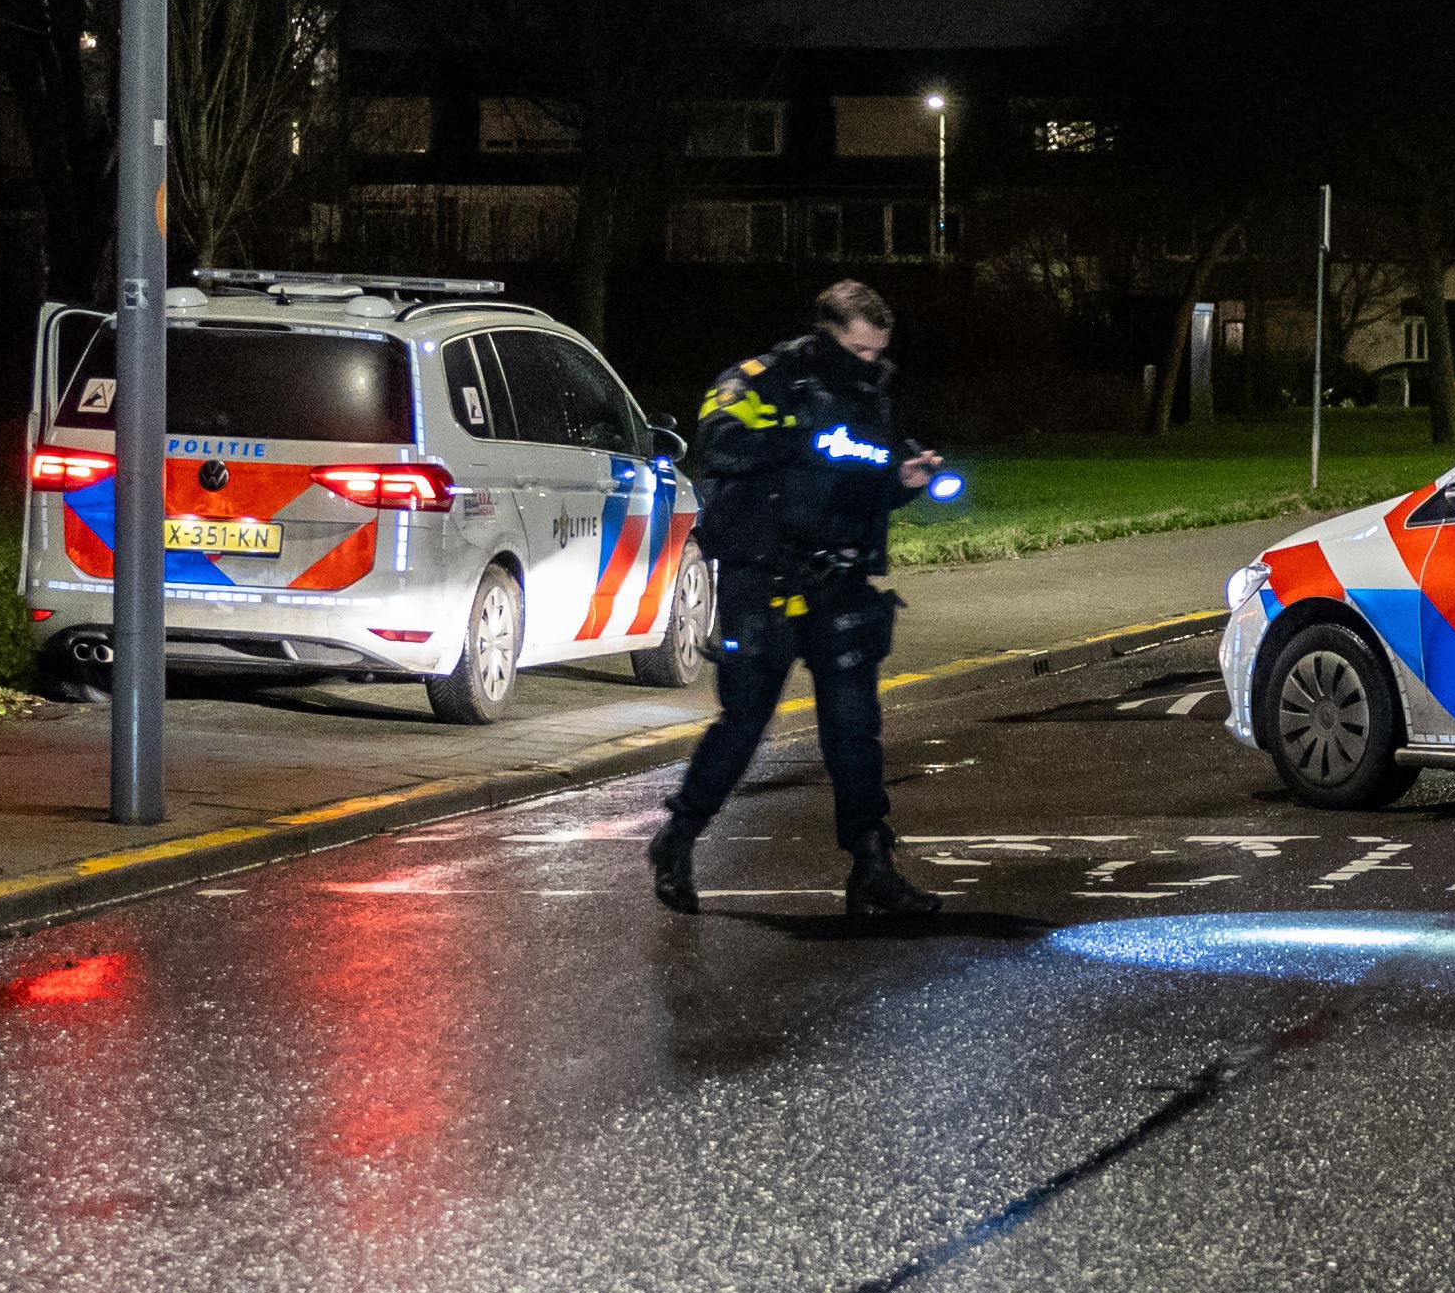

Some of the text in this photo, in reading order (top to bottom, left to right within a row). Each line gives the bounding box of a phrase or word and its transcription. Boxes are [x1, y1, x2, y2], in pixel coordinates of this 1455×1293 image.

[168, 439, 267, 458] POLITIE
[168, 525, 269, 548] X-351-KN
[553, 516, 598, 549] POLITIE
